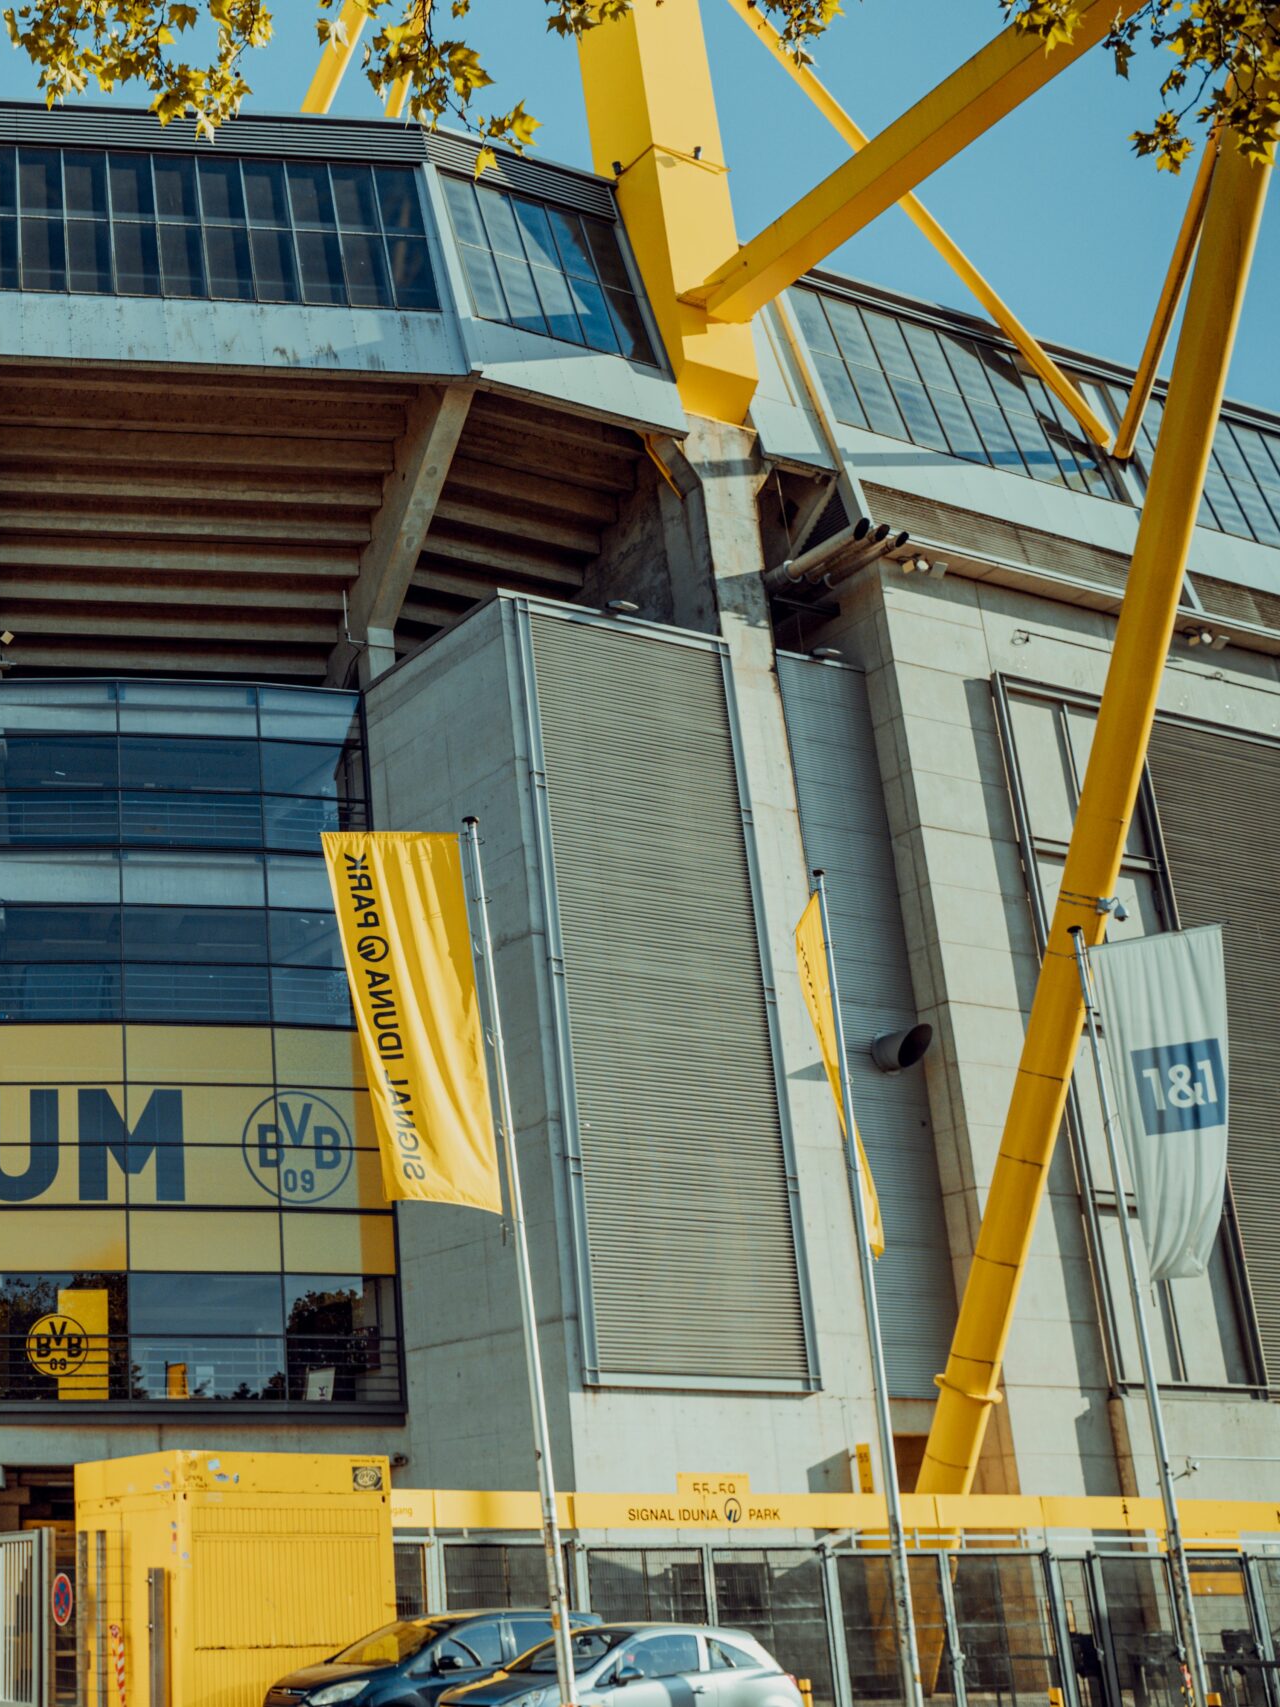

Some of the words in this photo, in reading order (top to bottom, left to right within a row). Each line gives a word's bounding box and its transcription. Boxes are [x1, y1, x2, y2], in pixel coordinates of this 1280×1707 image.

[1142, 1059, 1218, 1111] 1&1
[257, 1101, 341, 1170] BVB
[282, 1168, 315, 1193] 09
[36, 1321, 82, 1358] BVB
[50, 1358, 67, 1371] 09
[628, 1508, 675, 1522] SIGNAL
[678, 1508, 719, 1522] IDUNA
[748, 1508, 781, 1521] PARK
